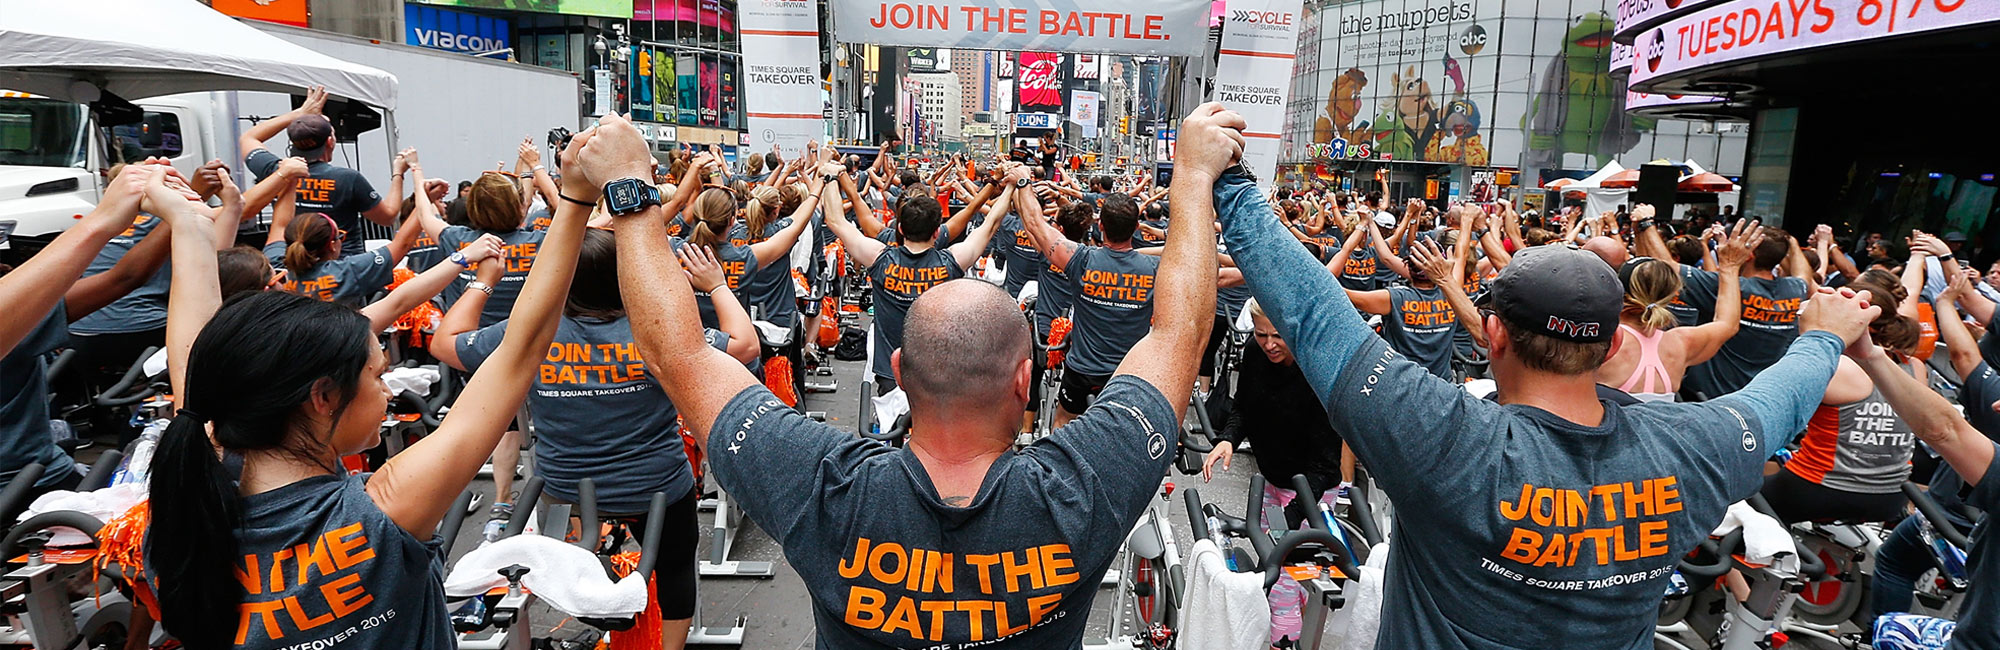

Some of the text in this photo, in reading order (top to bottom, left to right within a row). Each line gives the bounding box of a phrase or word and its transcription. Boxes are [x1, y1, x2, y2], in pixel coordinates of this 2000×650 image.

[870, 3, 1170, 40] JOIN THE BATTLE.
[1248, 11, 1292, 25] CYCLE
[1341, 16, 1372, 35] the
[1460, 30, 1486, 46] abc
[1677, 0, 1834, 60] TUESDAYS
[750, 65, 810, 74] TIMES SQUARE
[749, 73, 815, 84] TAKEOVER
[1222, 84, 1280, 94] TIMES SQUARE
[1219, 92, 1281, 105] TAKEOVER
[304, 178, 336, 190] THE
[884, 264, 948, 280] JOIN THE
[1082, 270, 1154, 288] JOIN THE
[1083, 283, 1147, 302] BATTLE
[1401, 298, 1451, 313] JOIN TH
[1404, 310, 1455, 325] BATTLE
[1743, 307, 1796, 323] BATTLE
[1547, 315, 1600, 337] NYR
[546, 343, 591, 362] OIN
[539, 364, 646, 384] BATTLE
[537, 389, 559, 397] TIMES
[560, 389, 593, 397] SQUARE
[595, 386, 635, 395] TAKEOVER
[1854, 416, 1895, 431] THE
[1500, 476, 1683, 527] JOIN THE
[1500, 520, 1669, 568] BATTLE
[838, 537, 1080, 594] JOIN THE
[1481, 557, 1673, 591] TIMES SQUARE TAKEOVER 2015
[360, 609, 396, 630] 2015
